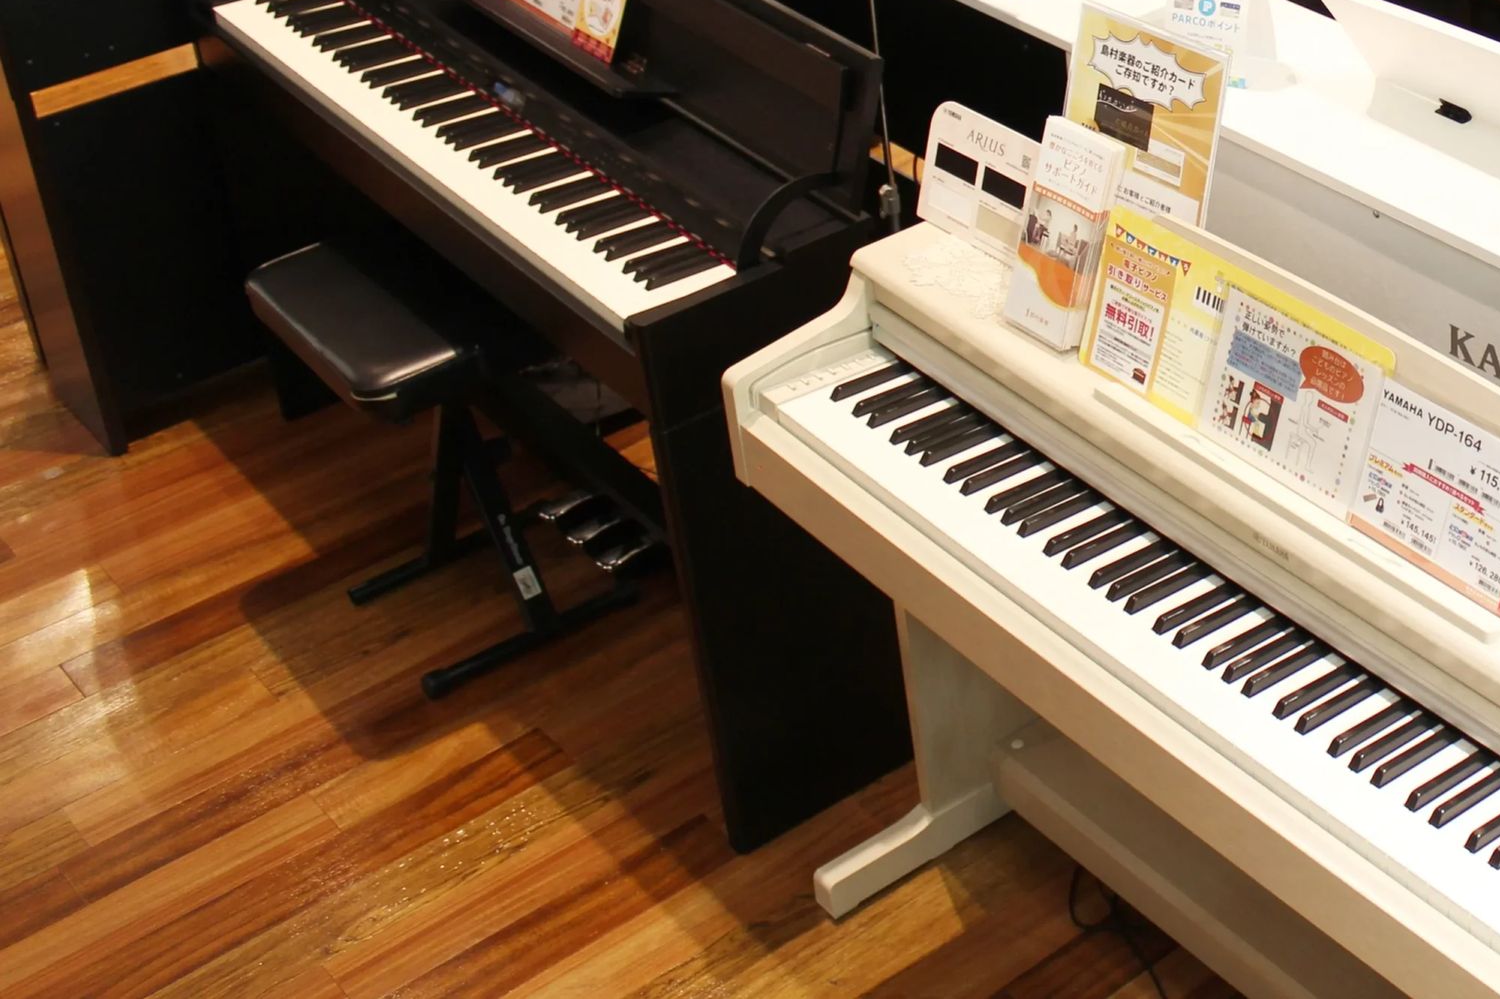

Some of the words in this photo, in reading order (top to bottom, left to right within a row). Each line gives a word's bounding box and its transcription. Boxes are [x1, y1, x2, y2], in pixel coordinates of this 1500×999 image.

[1171, 12, 1241, 34] PARCOポイント
[1100, 43, 1197, 91] 島村楽器のご紹介カード
[1114, 63, 1176, 97] ご存知ですか?
[966, 129, 1006, 158] ARIUS
[1044, 162, 1097, 195] サポートガイド
[1063, 158, 1087, 176] ピアノ
[1107, 264, 1168, 301] 引き取りサービス
[1123, 257, 1158, 281] 電子ピアノ
[1105, 302, 1155, 342] 無料引取!
[1241, 321, 1297, 356] 弾けていますか?
[1244, 308, 1286, 338] 正しい姿勢で
[1315, 369, 1346, 392] レッスンの
[1383, 388, 1423, 419] YAMAHA
[1427, 412, 1482, 453] YDP-164
